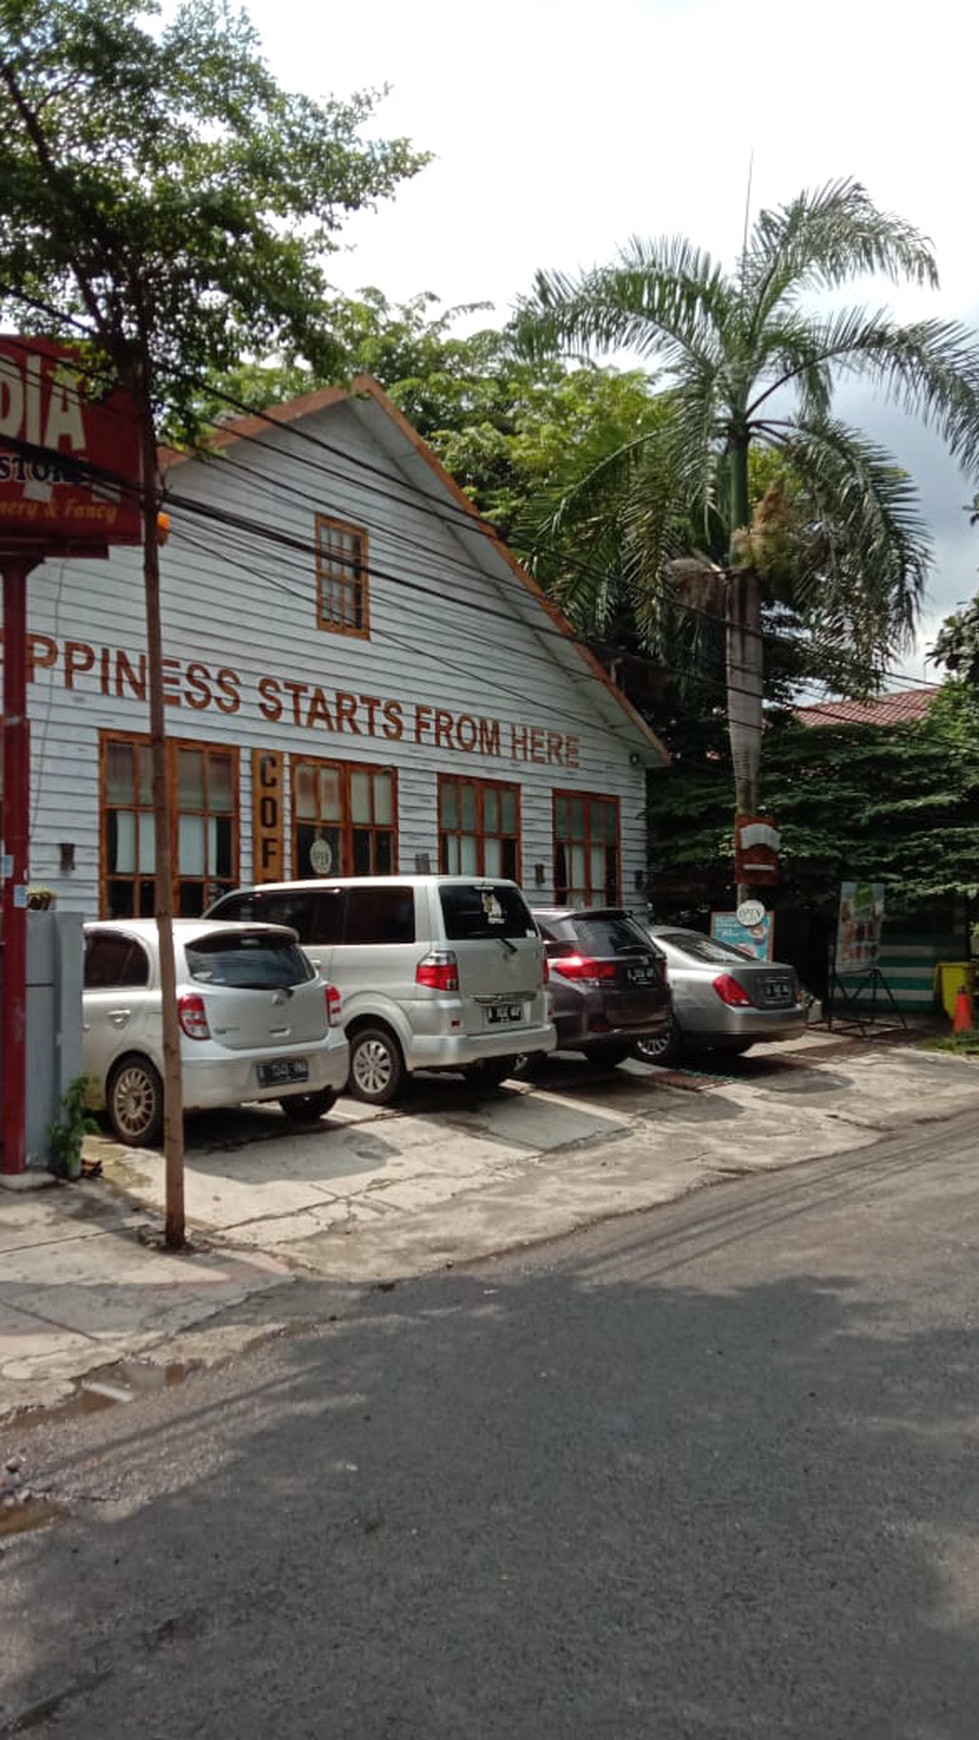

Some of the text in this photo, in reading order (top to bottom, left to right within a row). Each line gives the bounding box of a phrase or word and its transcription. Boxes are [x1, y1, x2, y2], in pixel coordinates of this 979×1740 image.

[64, 498, 117, 525] Fancy
[0, 629, 580, 769] PPINESS STARTS FROM HERE
[260, 755, 281, 883] COF
